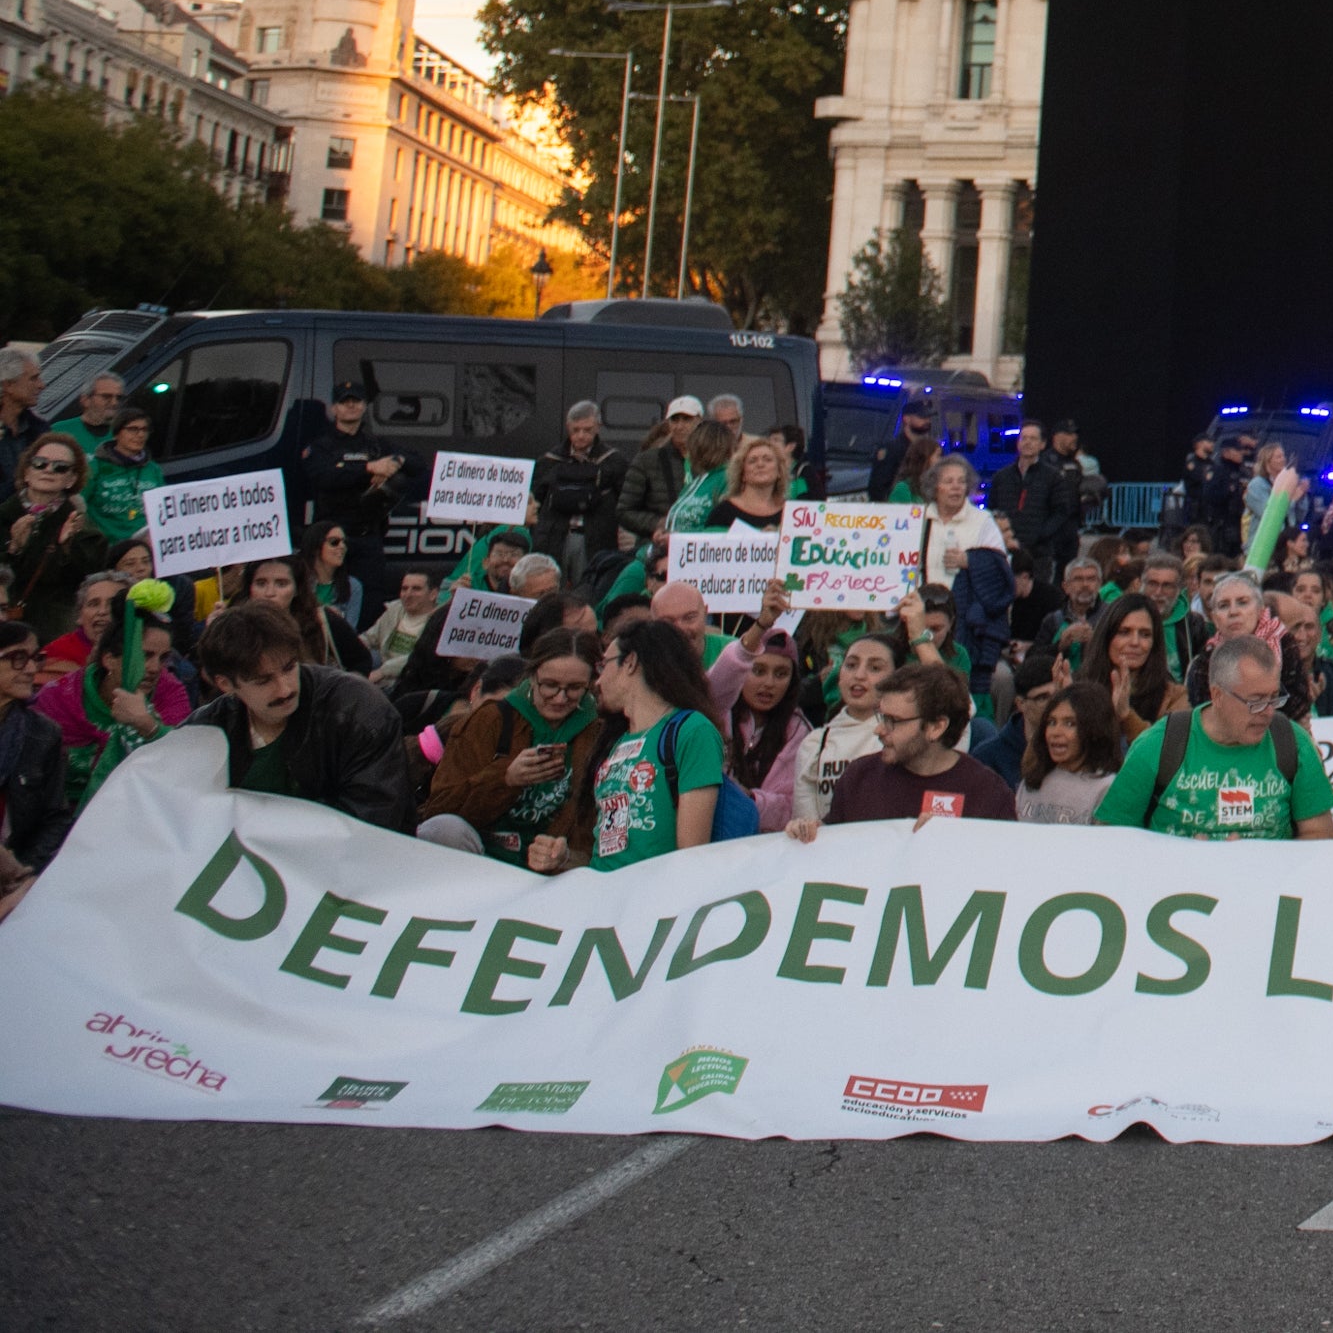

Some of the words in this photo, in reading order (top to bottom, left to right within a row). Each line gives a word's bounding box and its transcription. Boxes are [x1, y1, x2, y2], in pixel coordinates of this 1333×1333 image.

[729, 333, 774, 348] 1U-102
[440, 460, 456, 481] ¿El
[457, 463, 484, 481] dinero
[487, 466, 497, 481] de
[500, 465, 524, 484] todos
[158, 495, 176, 526] ¿El
[180, 493, 219, 516] dinero
[223, 487, 237, 509] de
[240, 482, 275, 506] todos
[433, 489, 454, 506] para
[456, 488, 486, 506] educar
[487, 494, 493, 507] a
[495, 492, 523, 510] ricos?
[824, 513, 887, 529] RECURSOS
[895, 518, 910, 531] LA
[159, 536, 185, 562] para
[189, 526, 229, 550] educar
[233, 531, 240, 543] a
[244, 514, 280, 541] ricos?
[679, 541, 696, 568] ¿El
[699, 541, 732, 561] dinero
[735, 543, 747, 561] de
[898, 551, 920, 566] NO
[701, 575, 736, 595] educar
[739, 579, 745, 594] a
[748, 574, 769, 595] rico
[805, 571, 898, 593] Florece
[459, 598, 481, 620] ¿El
[482, 603, 519, 623] dinero
[448, 626, 476, 644] para
[478, 628, 518, 649] educar
[1177, 770, 1229, 791] ESCUELA
[1182, 810, 1205, 824] DE
[1222, 805, 1253, 817] STEM
[175, 828, 1219, 1017] DEFENDEMOS
[697, 1056, 732, 1066] MENOS
[852, 1080, 943, 1103] CCOO
[843, 1098, 903, 1113] educación
[915, 1107, 967, 1119] servicios
